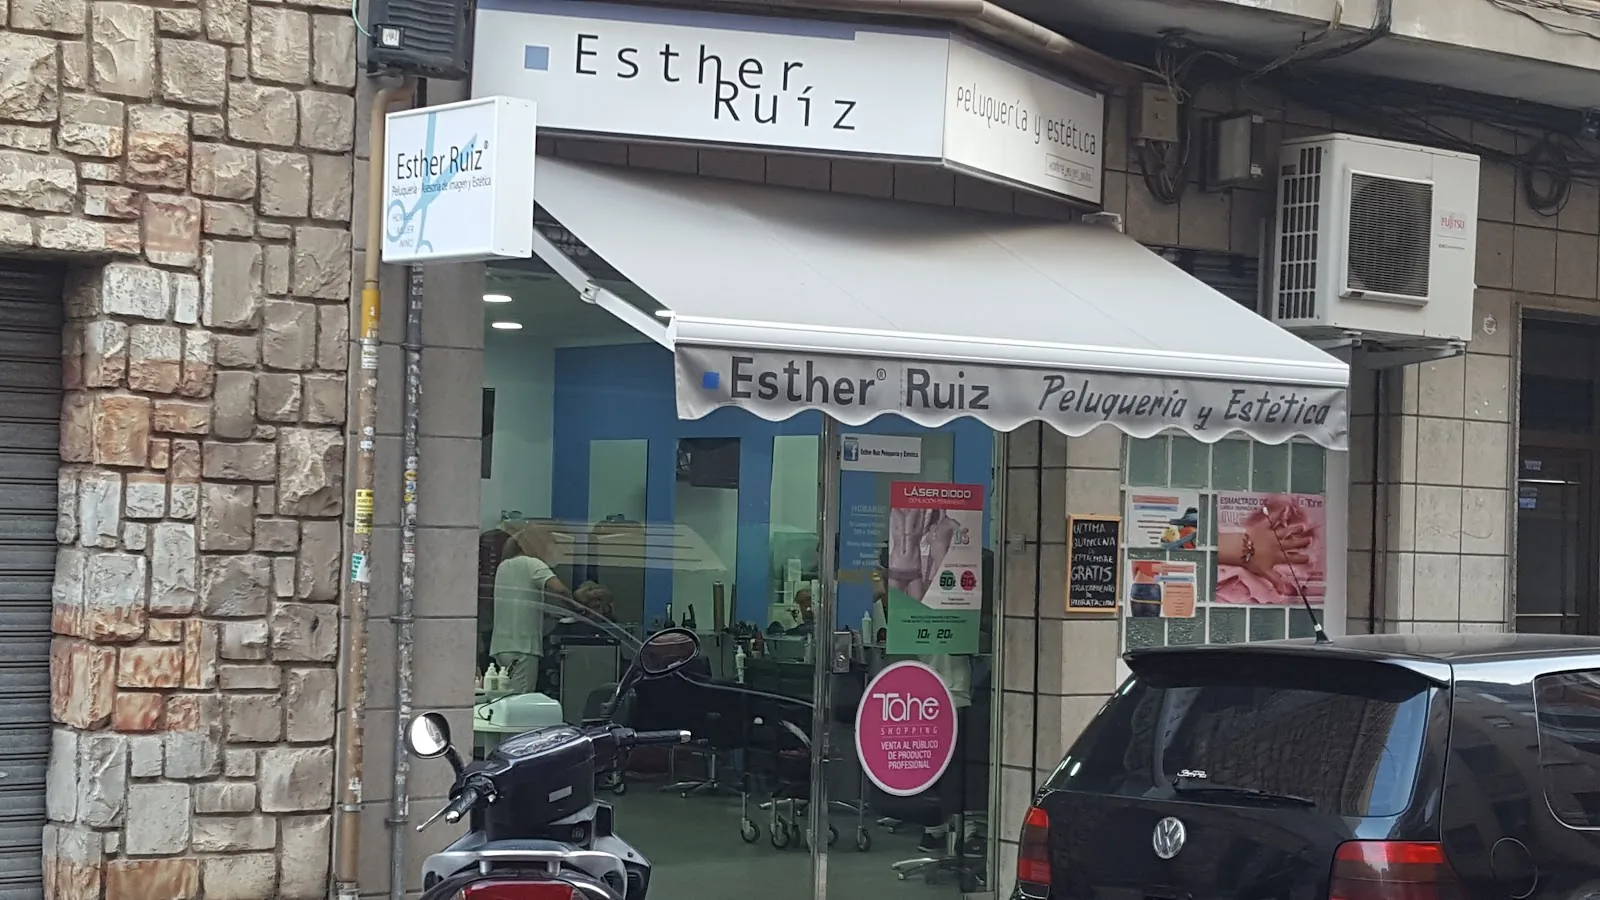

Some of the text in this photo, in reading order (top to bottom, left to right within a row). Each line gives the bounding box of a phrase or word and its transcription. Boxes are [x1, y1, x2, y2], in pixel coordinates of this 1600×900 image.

[576, 34, 804, 92] Esther
[713, 80, 858, 131] Ruíz
[1034, 114, 1041, 144] y
[1047, 118, 1096, 155] estética
[397, 149, 445, 180] Esther
[1441, 214, 1465, 230] FUJITSU
[906, 367, 990, 411] Ruiz
[1192, 405, 1213, 431] y
[1223, 388, 1331, 426] Estética
[903, 486, 972, 499] LÁSER DIODO
[1219, 496, 1258, 506] ESMALTADO
[1071, 564, 1113, 582] GRATIS
[873, 693, 940, 722] Tahe
[880, 726, 938, 736] SHOPPING
[881, 741, 901, 750] VENTA
[902, 741, 911, 750] AL
[888, 750, 931, 760] DE PRODUCTO
[888, 760, 931, 770] PROFESIONAL
